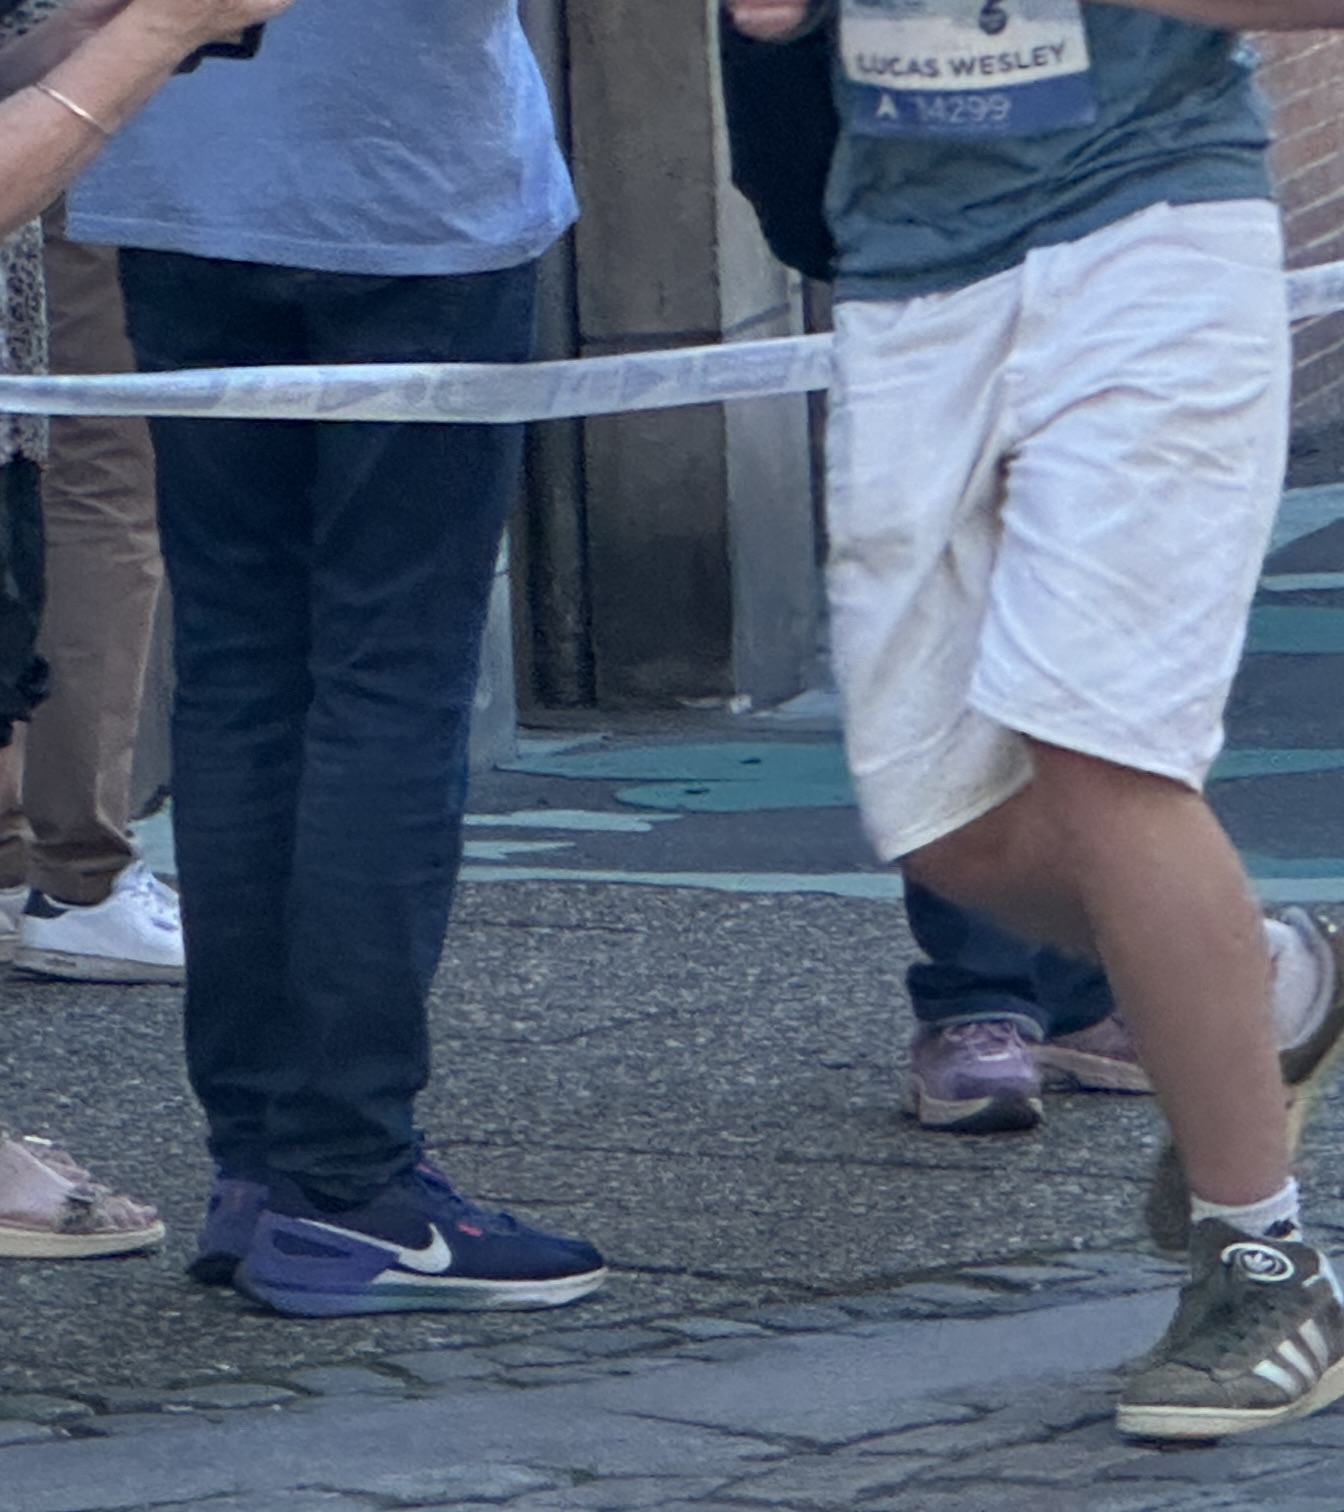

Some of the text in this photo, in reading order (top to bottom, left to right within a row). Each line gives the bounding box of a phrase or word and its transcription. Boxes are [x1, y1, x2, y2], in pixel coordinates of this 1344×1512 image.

[856, 43, 1066, 78] LUCAS WESLEY
[876, 95, 899, 120] A
